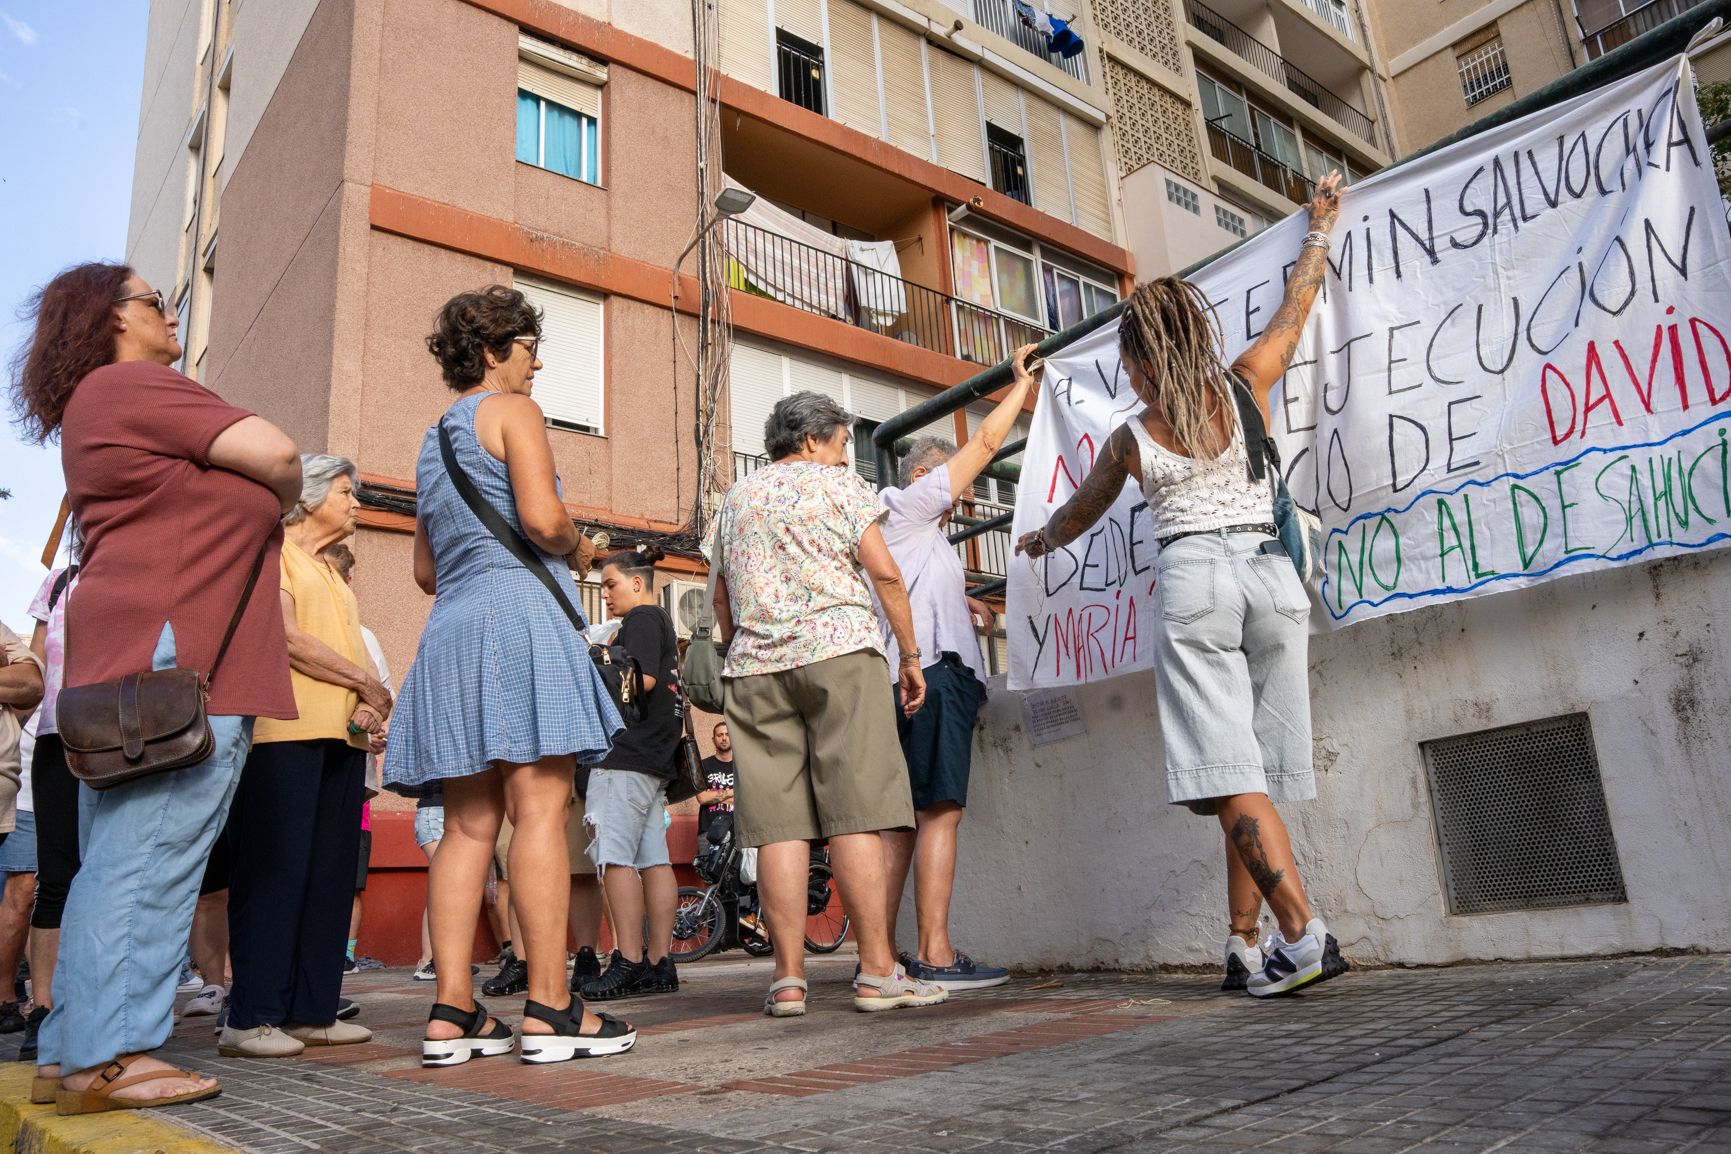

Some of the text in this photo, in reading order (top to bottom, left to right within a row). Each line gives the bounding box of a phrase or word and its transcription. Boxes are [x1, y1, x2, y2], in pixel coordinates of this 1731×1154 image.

[1387, 394, 1484, 493] DE
[1540, 305, 1731, 446] DAVID
[1336, 513, 1402, 610] NO
[1437, 493, 1501, 584] AL
